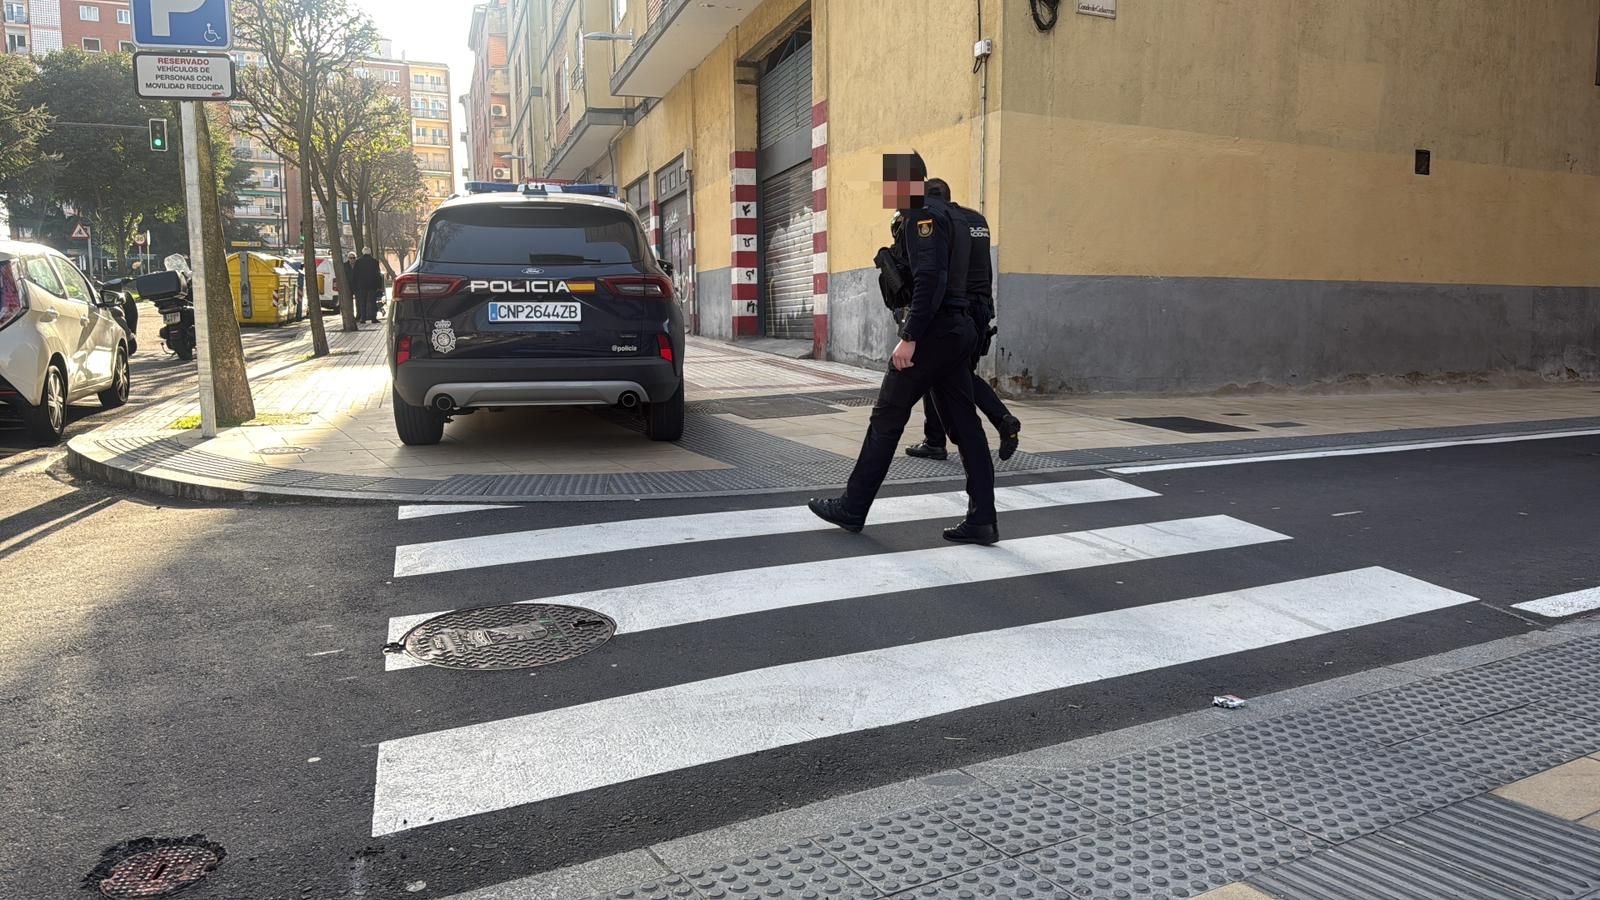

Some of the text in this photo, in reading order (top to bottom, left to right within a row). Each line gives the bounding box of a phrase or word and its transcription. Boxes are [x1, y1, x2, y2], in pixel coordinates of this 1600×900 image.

[157, 57, 209, 66] RESERVADO
[156, 65, 211, 74] VEHÍCULOS DE
[145, 82, 225, 91] MOVILIDAD REDUCIDA
[470, 280, 571, 293] POLICIA
[498, 304, 578, 319] CNP2644ZB
[611, 344, 638, 352] @policia
